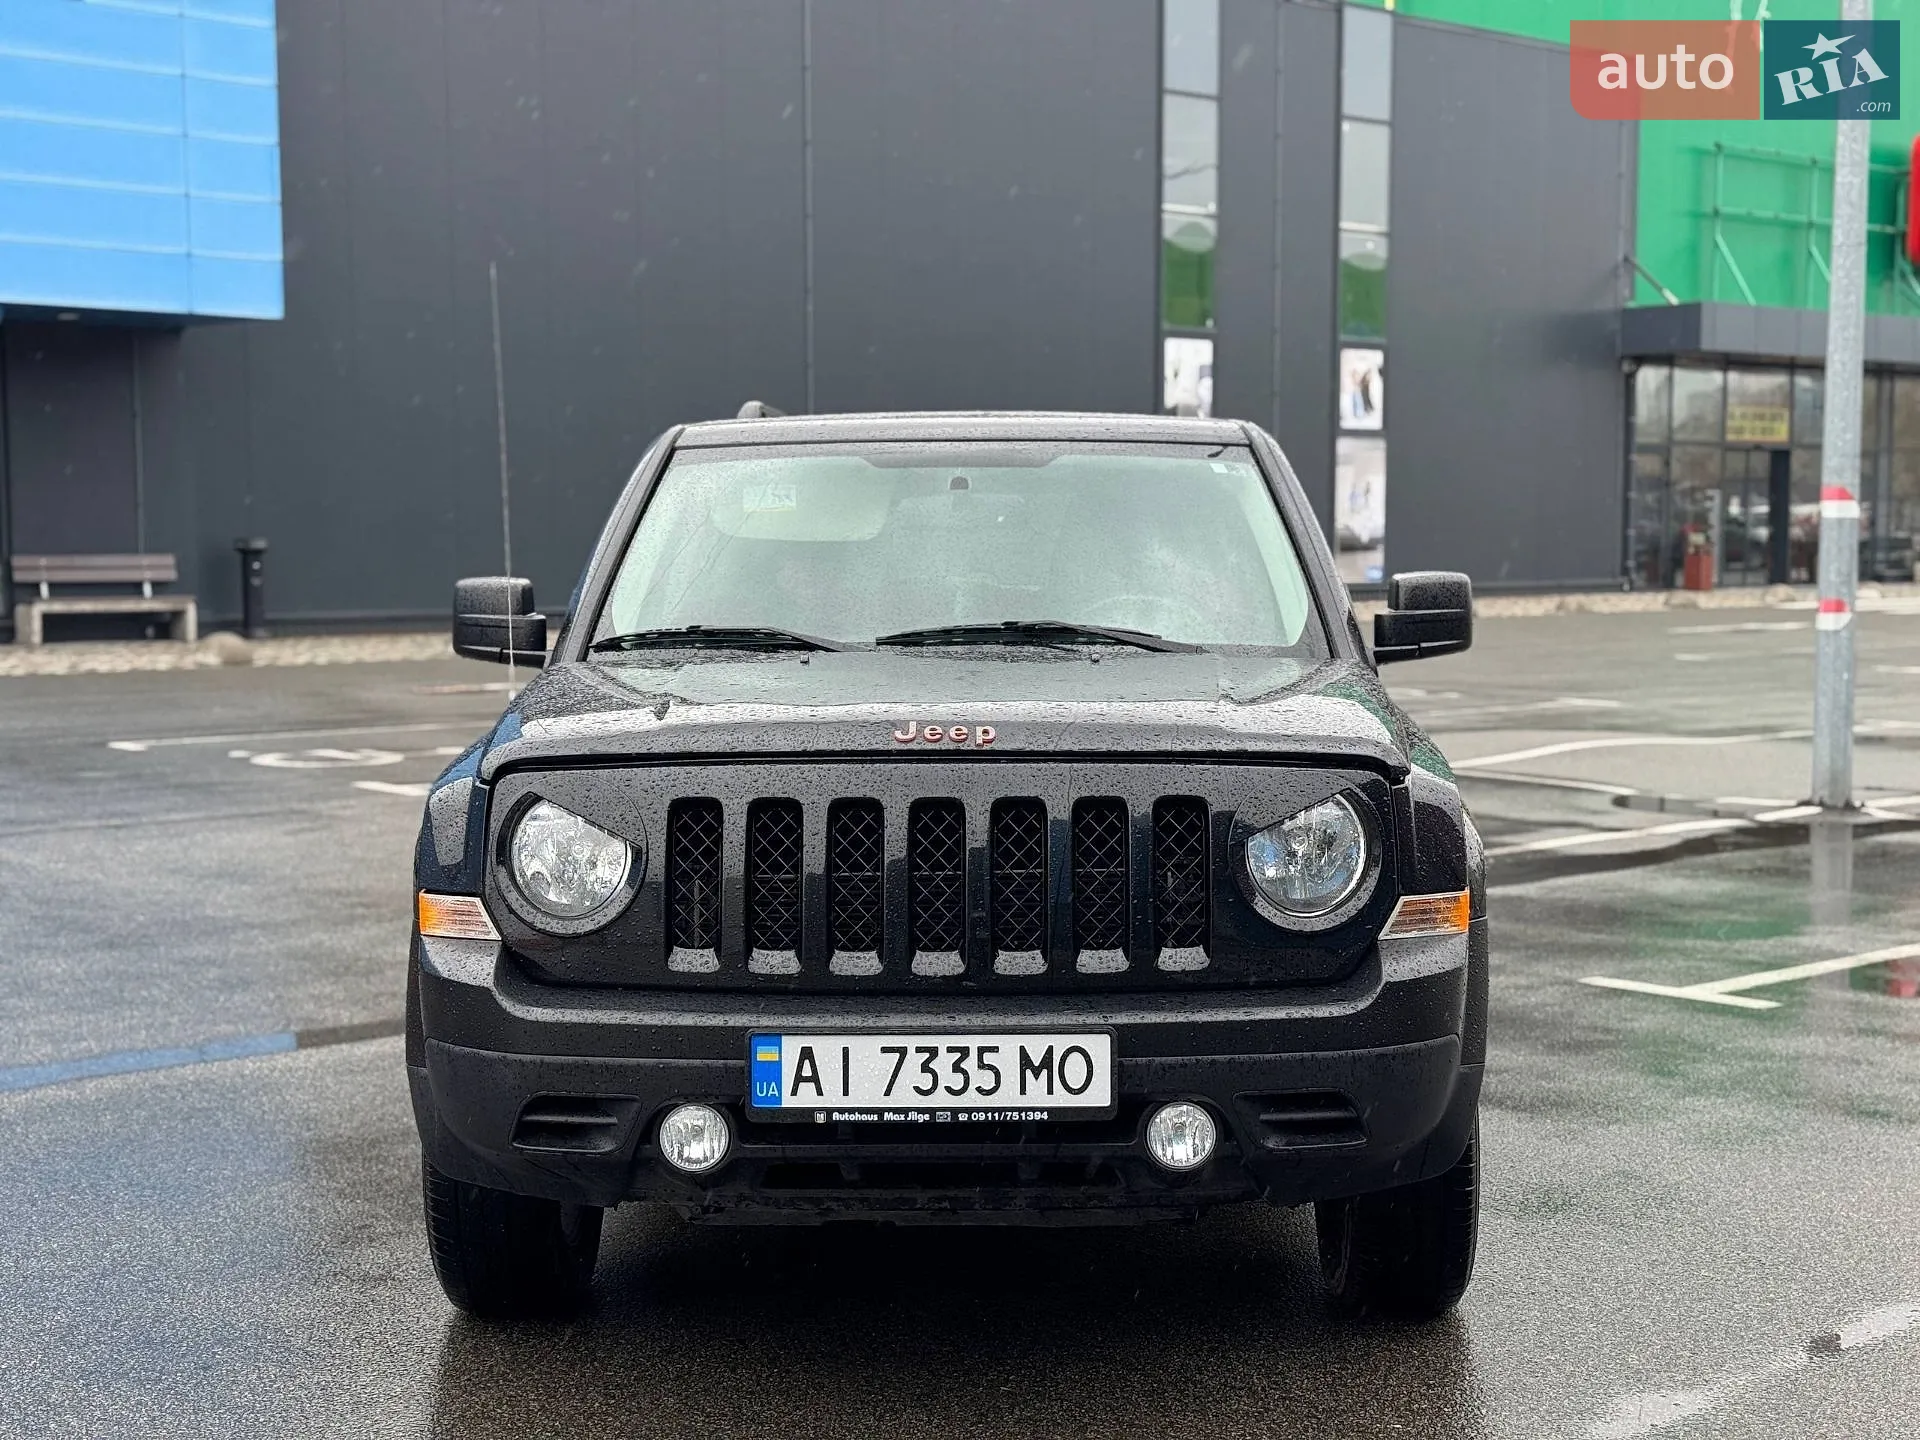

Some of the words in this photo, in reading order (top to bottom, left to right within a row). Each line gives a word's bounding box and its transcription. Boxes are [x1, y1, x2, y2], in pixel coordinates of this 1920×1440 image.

[894, 720, 997, 747] Jeep
[789, 1045, 850, 1097] AI
[879, 1045, 1002, 1097] 7335
[1018, 1044, 1095, 1097] MO
[756, 1081, 780, 1098] UA
[832, 1111, 879, 1121] Autohaus
[883, 1111, 906, 1121] Max
[907, 1110, 931, 1123] Jilge
[971, 1111, 1049, 1121] 0911/751394
